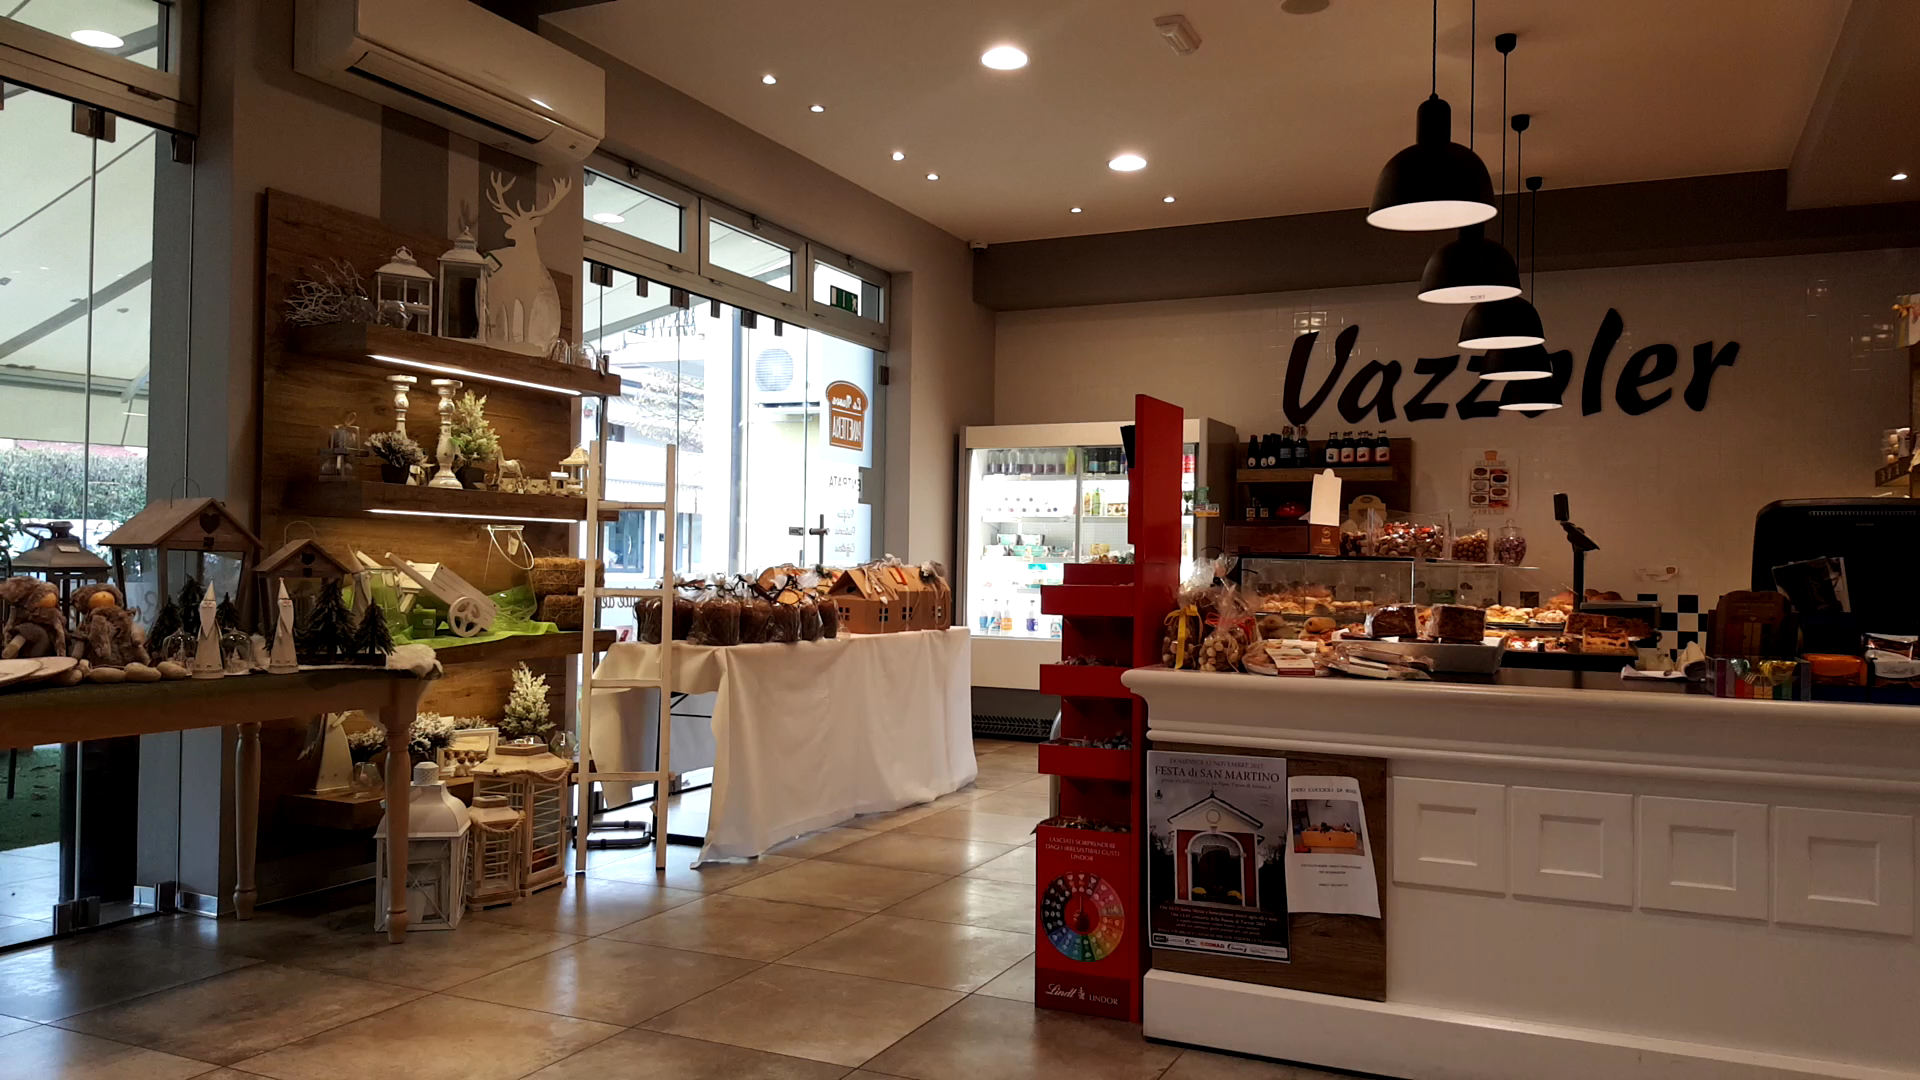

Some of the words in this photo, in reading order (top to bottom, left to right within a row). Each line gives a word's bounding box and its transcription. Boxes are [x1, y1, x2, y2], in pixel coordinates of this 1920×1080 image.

[1155, 766, 1186, 776] FESTA
[1188, 767, 1198, 777] di
[1200, 769, 1222, 779] SAN
[1224, 770, 1280, 783] MARTINO
[1049, 836, 1074, 845] LASCIATI
[1075, 839, 1116, 849] SORPRENDERE
[1045, 843, 1063, 851] DAGLI
[1064, 845, 1101, 855] IRRESISTIBILI
[1101, 849, 1120, 857] GUSTI
[1070, 853, 1094, 862] LINDOR
[1045, 983, 1077, 999] Lindt
[1089, 994, 1119, 1005] LINDOR
